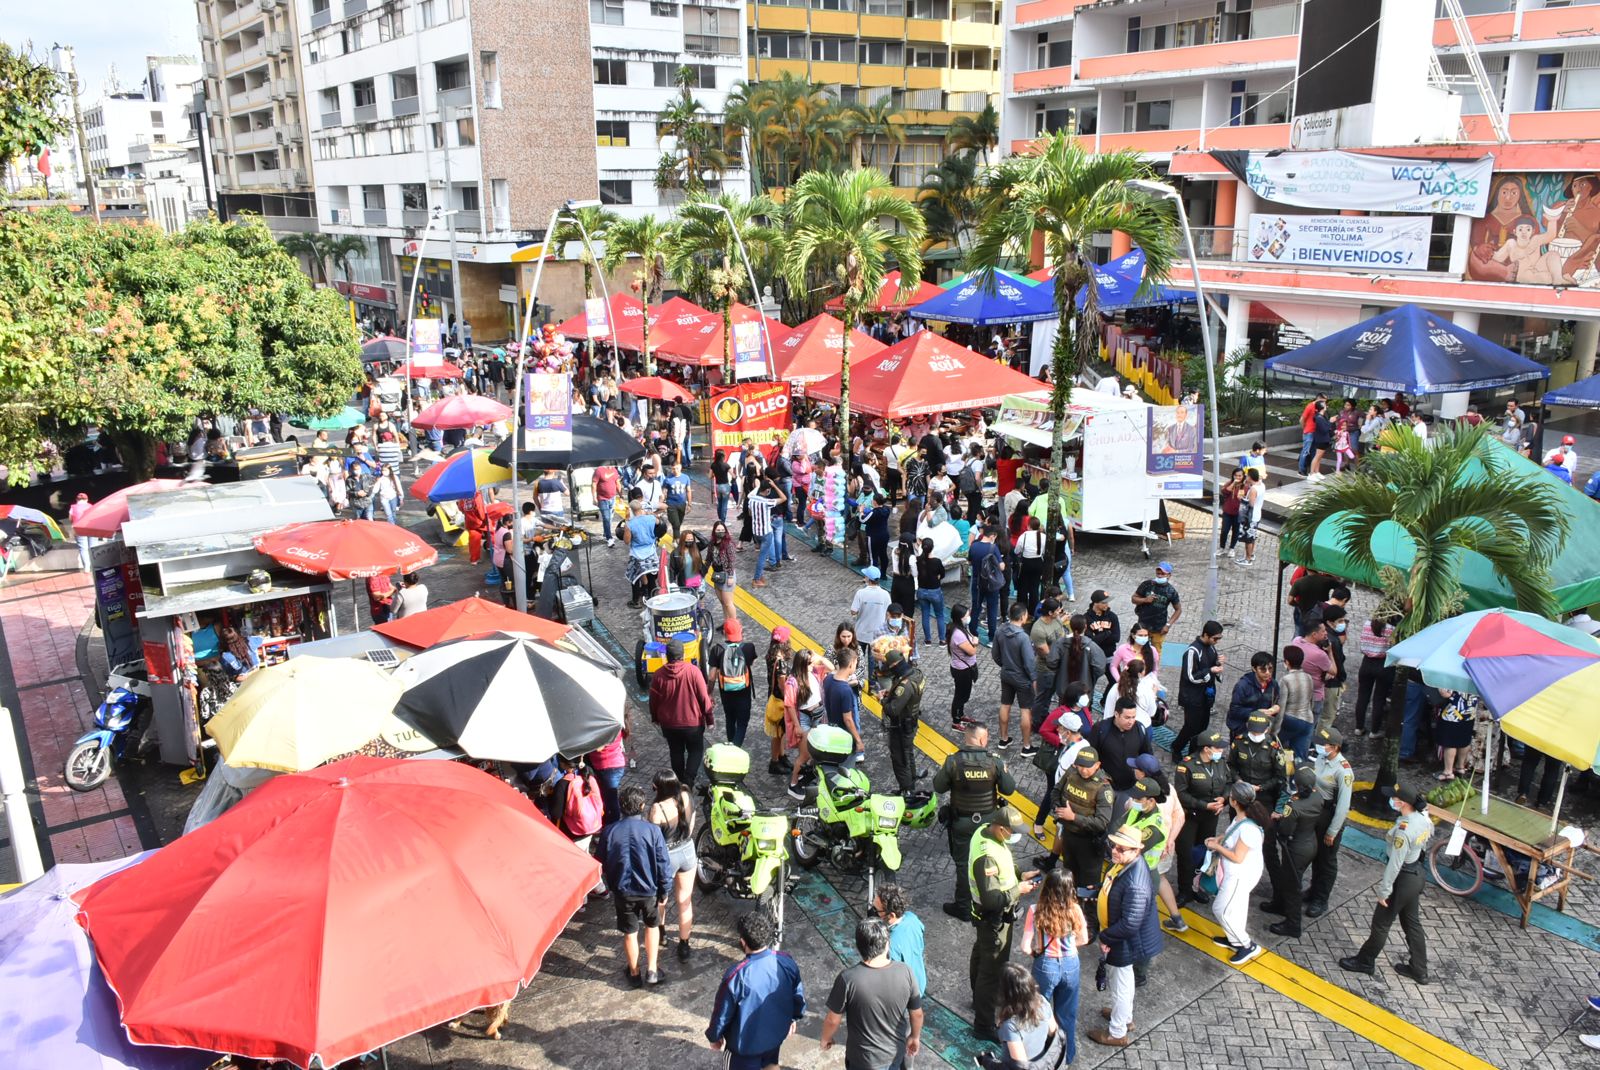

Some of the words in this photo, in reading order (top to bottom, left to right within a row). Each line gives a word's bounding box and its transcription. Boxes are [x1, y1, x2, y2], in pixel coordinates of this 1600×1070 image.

[1303, 115, 1332, 130] Soluciones
[1418, 180, 1479, 196] NADOS
[1356, 331, 1392, 345] ROJA
[1429, 333, 1463, 346] ROJA
[927, 358, 966, 372] ROJA
[745, 394, 788, 418] D'LEO
[533, 415, 550, 428] 36
[1154, 455, 1175, 470] 36
[286, 546, 320, 560] Claro
[393, 545, 420, 557] Claro
[349, 569, 378, 578] Claro
[661, 614, 690, 622] DELICIOSA
[1066, 783, 1088, 800] POLICIA
